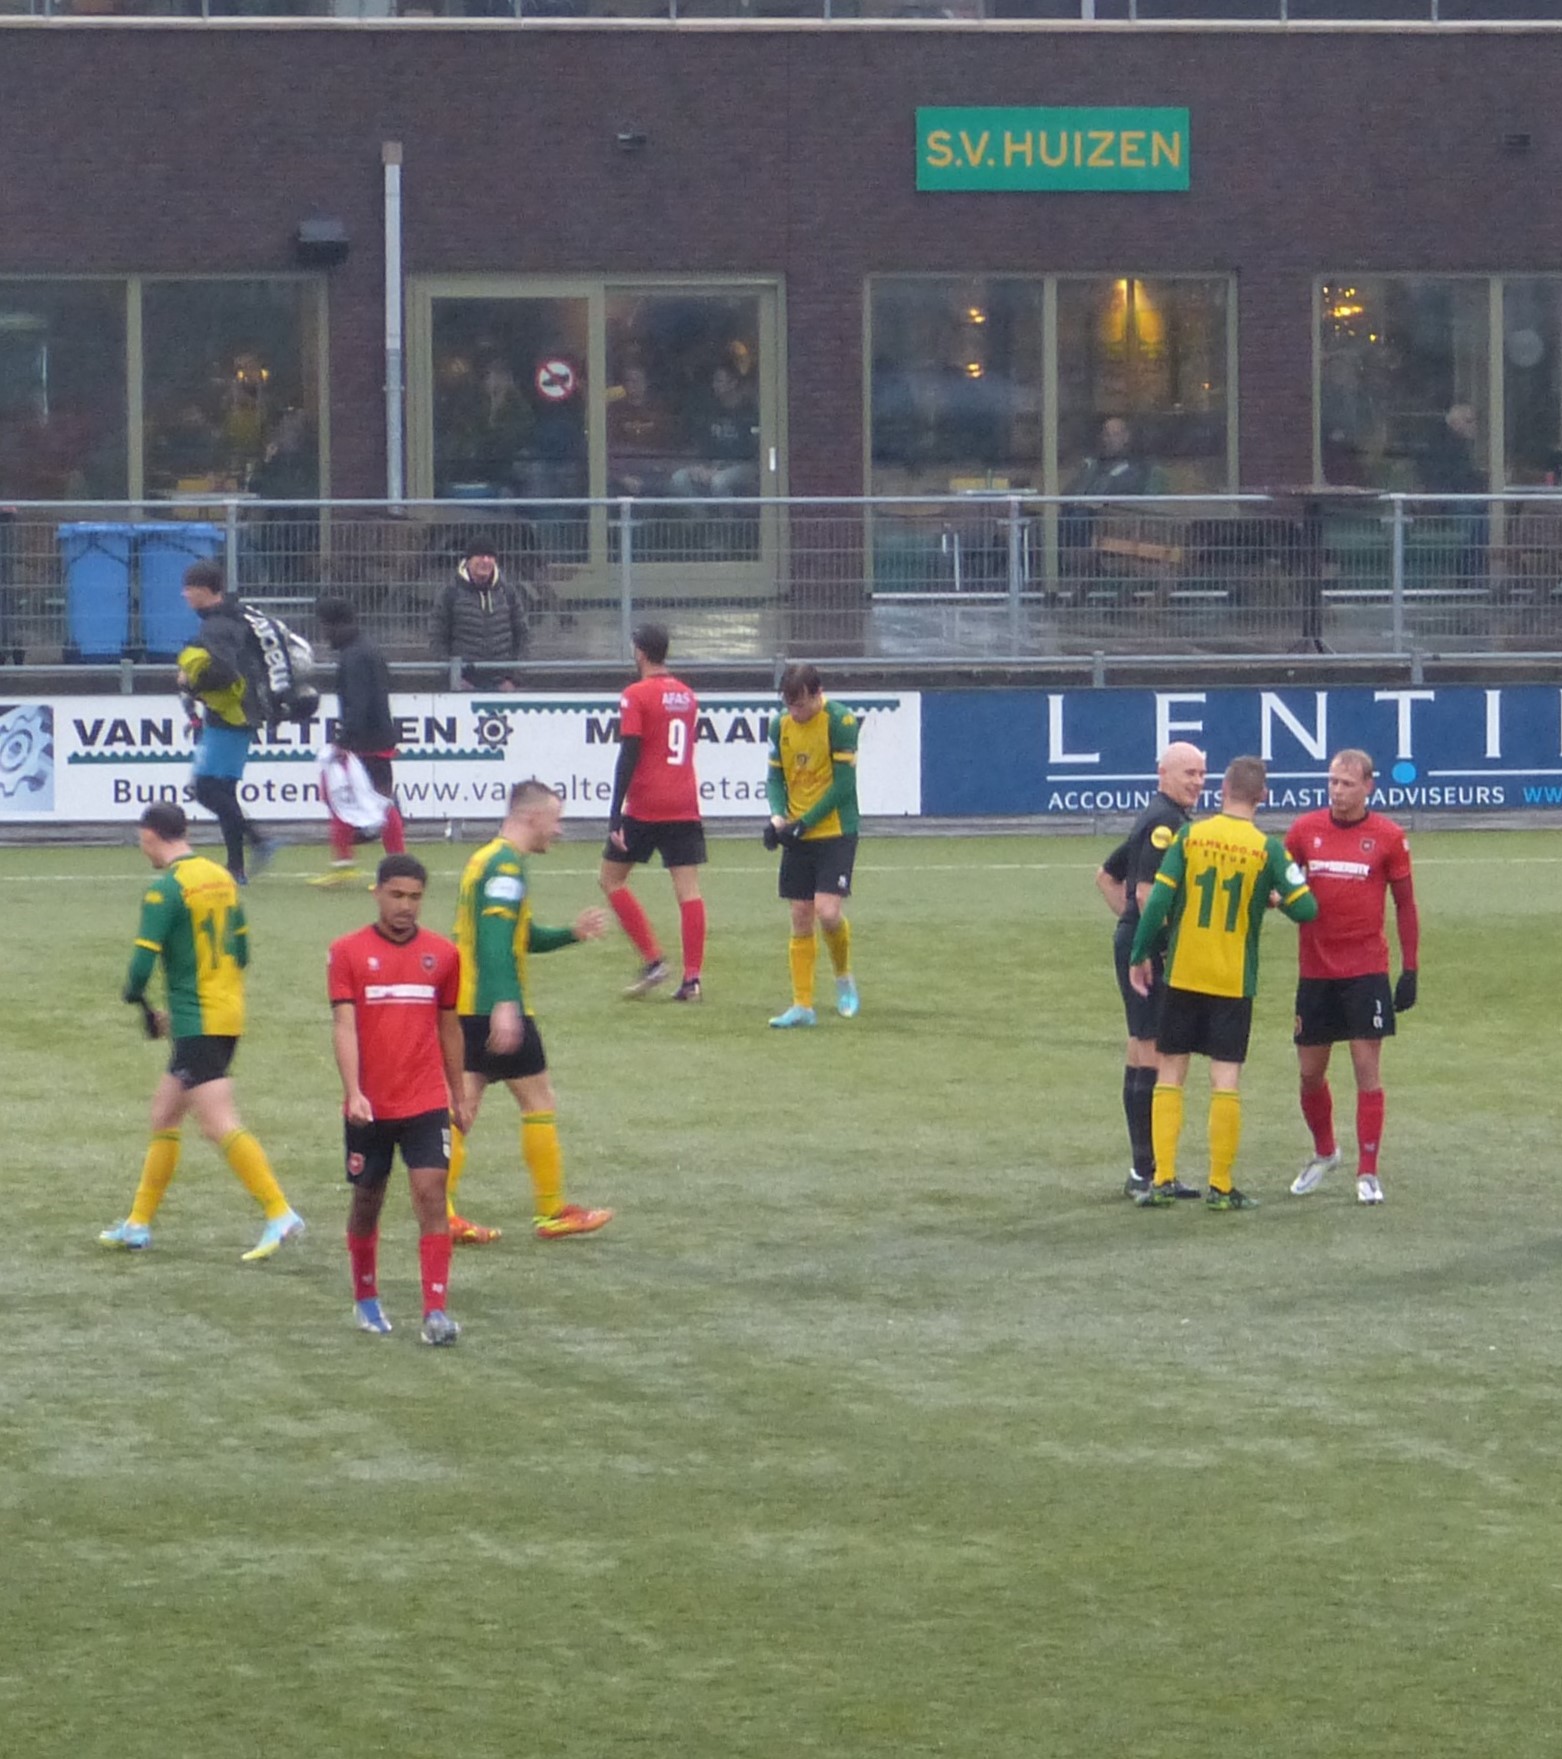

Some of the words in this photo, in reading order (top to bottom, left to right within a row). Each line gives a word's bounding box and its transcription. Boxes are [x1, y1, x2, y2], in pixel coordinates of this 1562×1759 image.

[72, 718, 174, 747] VAN
[666, 718, 686, 766] 9
[113, 778, 321, 804] Bunsoten
[1048, 789, 1223, 809] ACCOUNTS
[1195, 866, 1246, 932] 11
